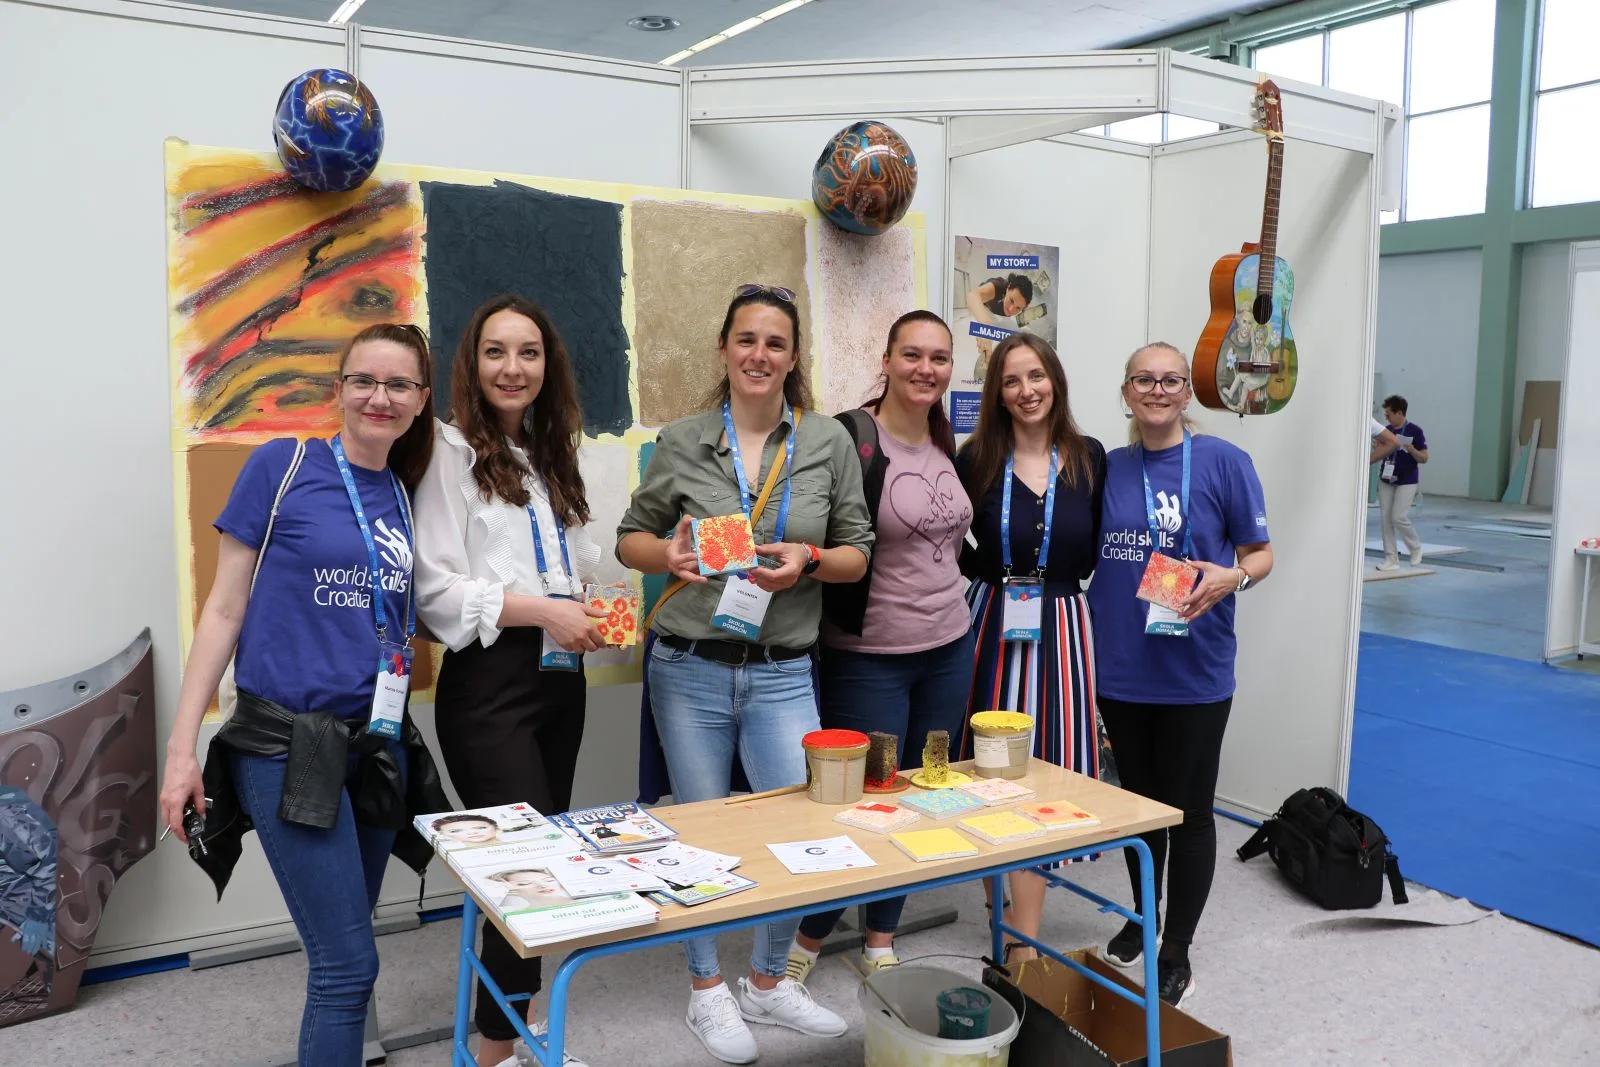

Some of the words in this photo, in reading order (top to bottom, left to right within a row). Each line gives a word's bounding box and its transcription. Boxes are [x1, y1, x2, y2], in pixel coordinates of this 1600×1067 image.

[989, 258, 1002, 267] MY
[1101, 544, 1144, 562] Croatia
[313, 585, 371, 609] Croatia
